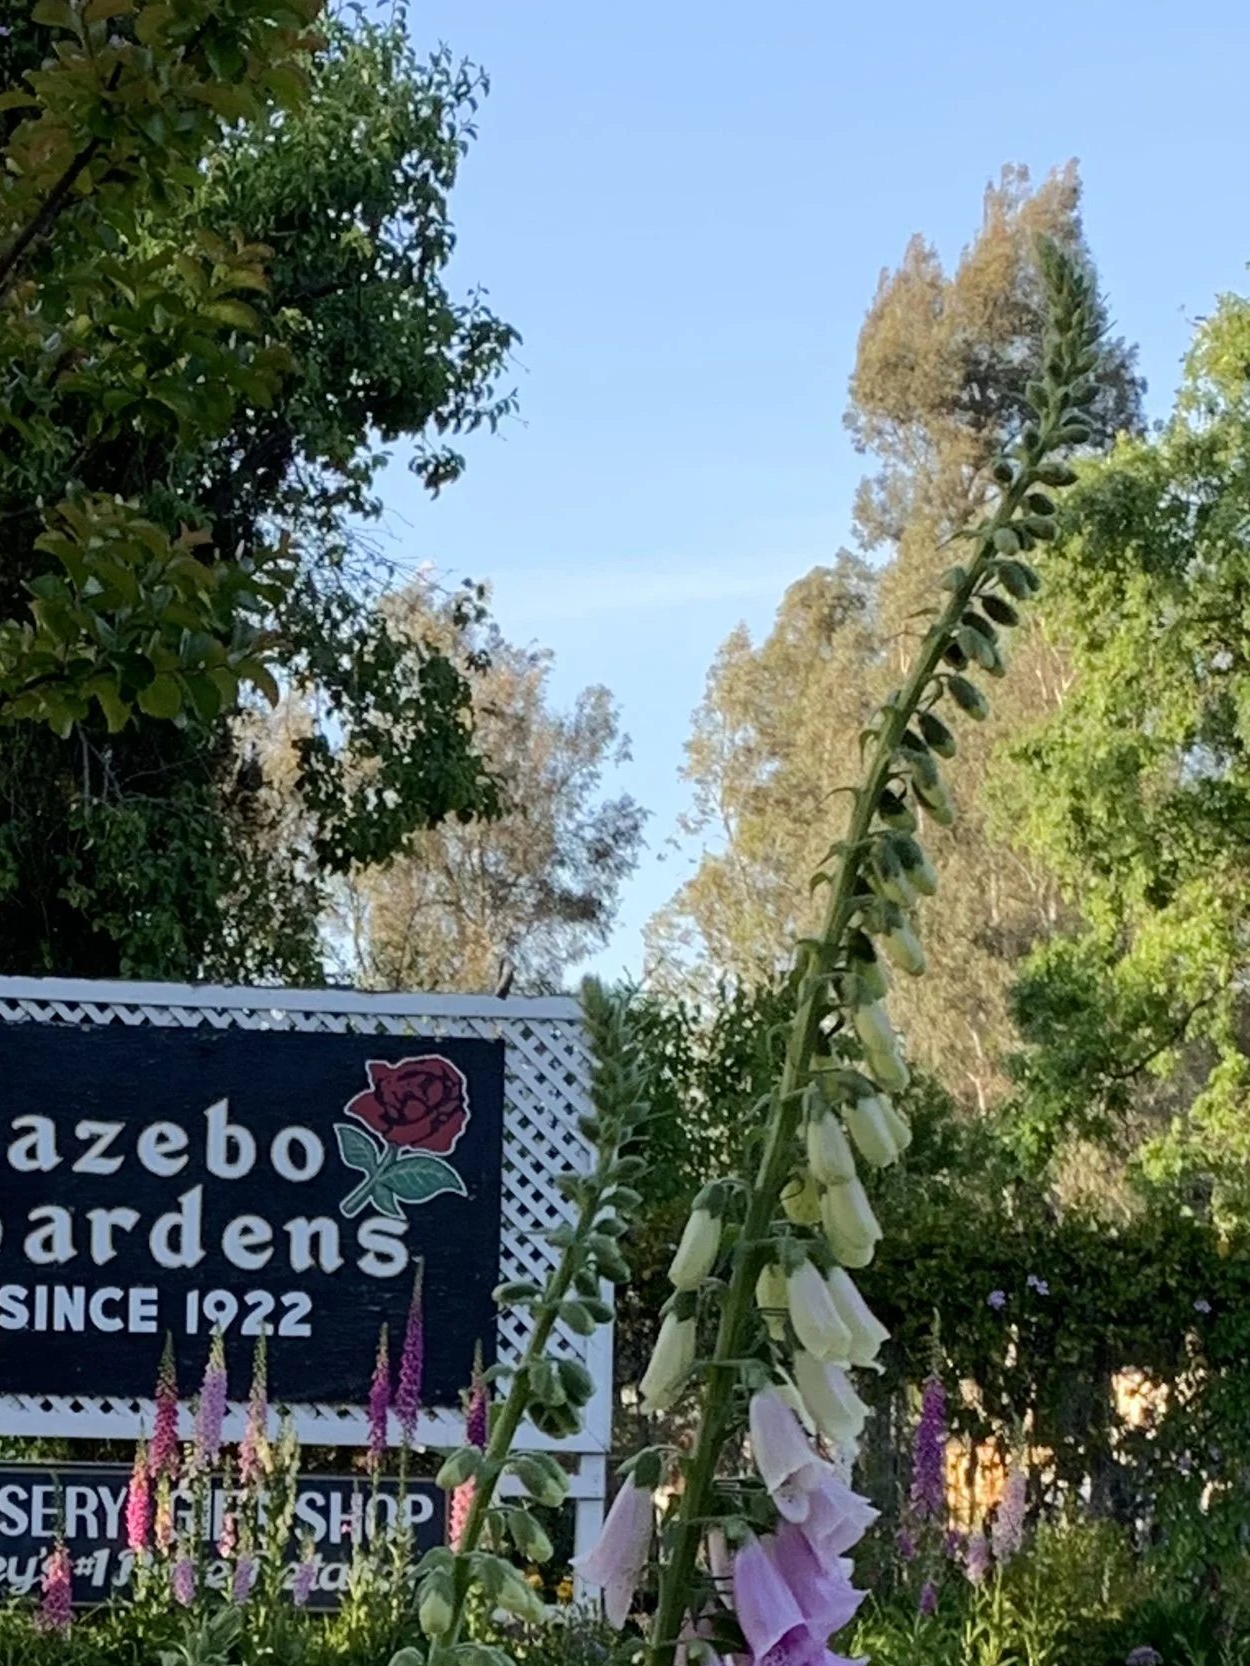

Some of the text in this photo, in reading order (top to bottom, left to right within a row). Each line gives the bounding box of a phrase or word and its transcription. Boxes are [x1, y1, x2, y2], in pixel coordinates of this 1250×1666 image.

[185, 1289, 313, 1338] 1922
[294, 1491, 435, 1544] SHOP
[72, 1548, 111, 1588] #1
